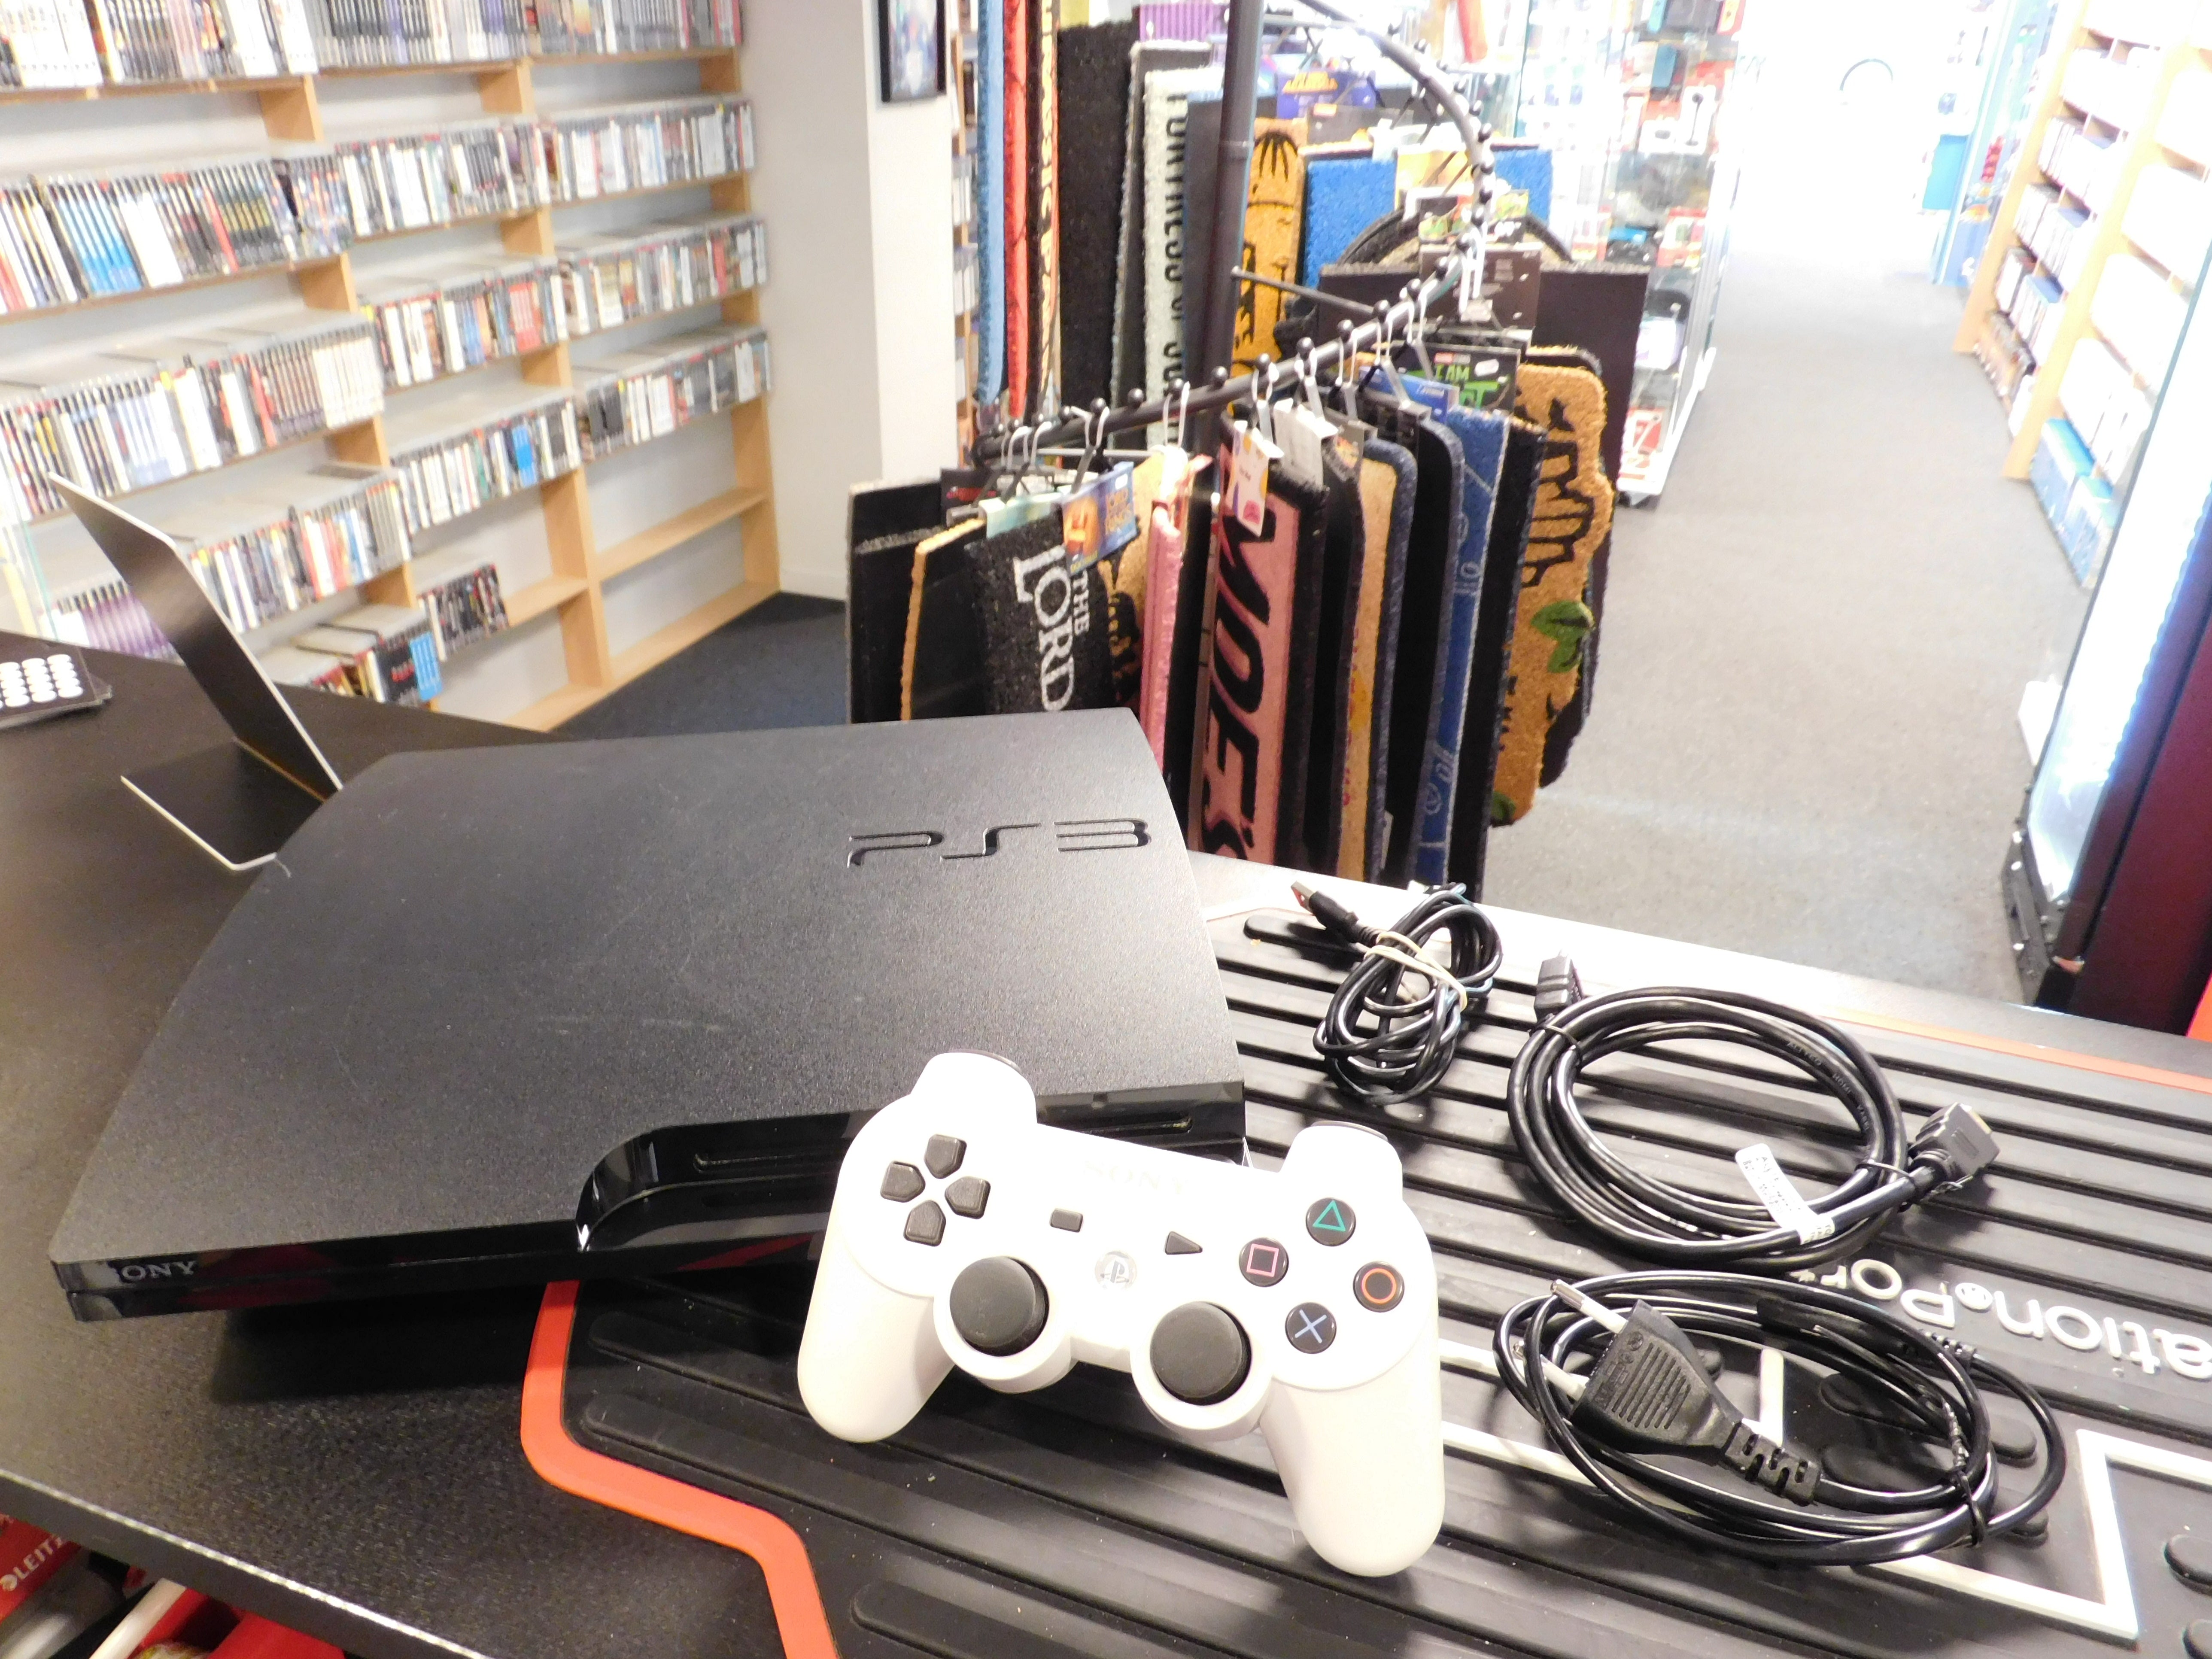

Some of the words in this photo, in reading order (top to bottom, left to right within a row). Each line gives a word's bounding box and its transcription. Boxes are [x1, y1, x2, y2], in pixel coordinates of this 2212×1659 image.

[1013, 544, 1074, 711] LORD
[847, 817, 1152, 869] PS3
[1083, 1160, 1189, 1194] SONY
[115, 1260, 198, 1282] ONY
